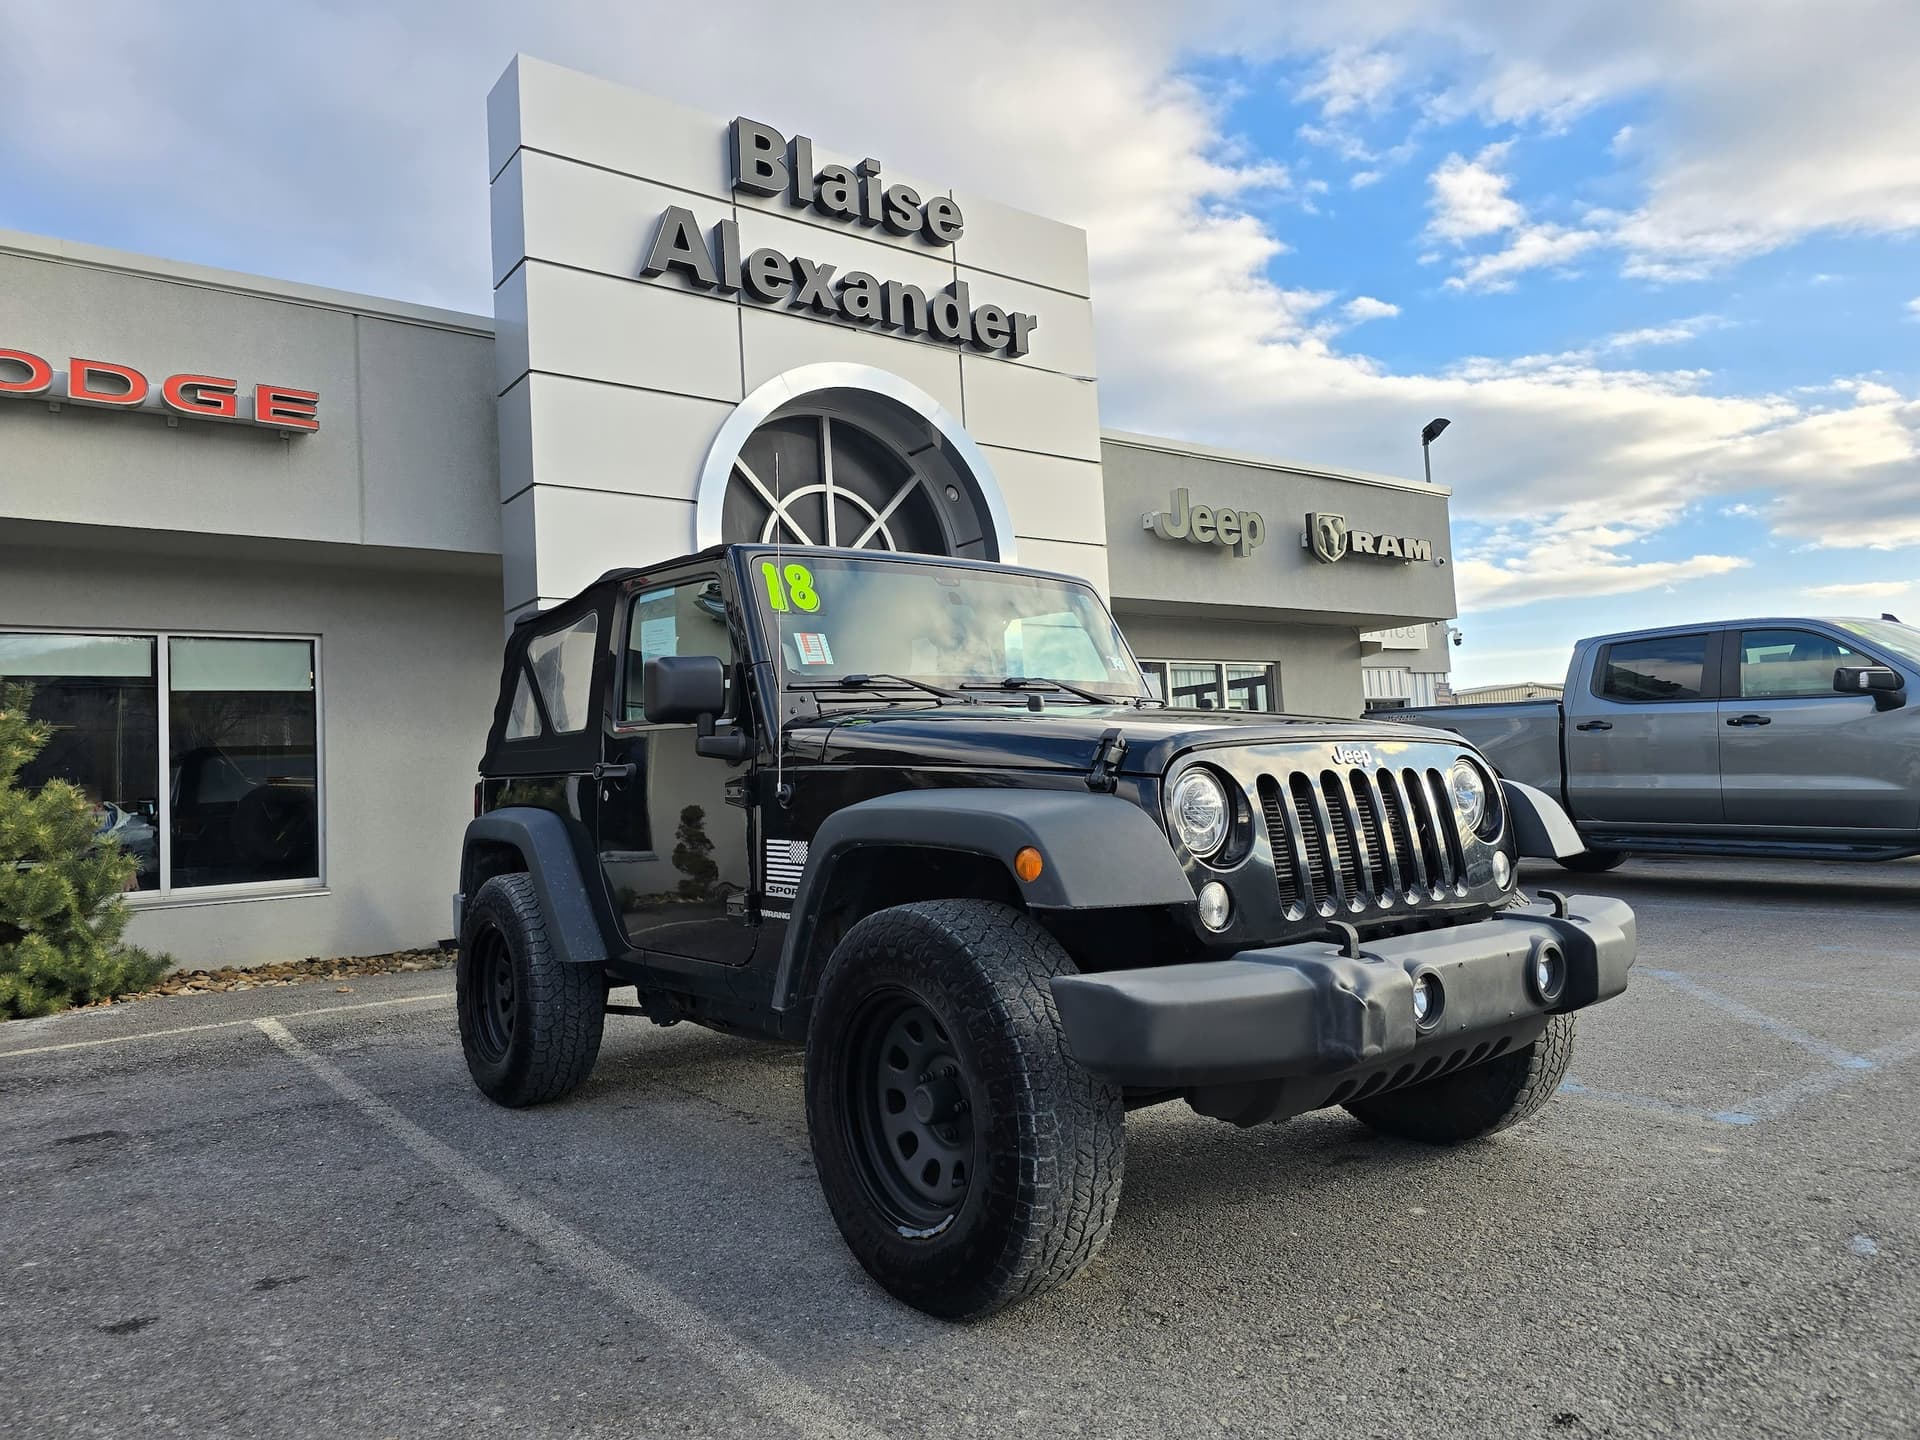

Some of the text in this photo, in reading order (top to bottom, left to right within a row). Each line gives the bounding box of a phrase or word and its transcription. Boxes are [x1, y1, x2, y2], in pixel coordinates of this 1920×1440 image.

[729, 116, 964, 247] Blaise
[640, 205, 1037, 358] Alexander
[1153, 487, 1266, 558] Jeep
[1349, 529, 1433, 562] RAM
[762, 562, 820, 613] 18
[1331, 745, 1372, 768] Jeep
